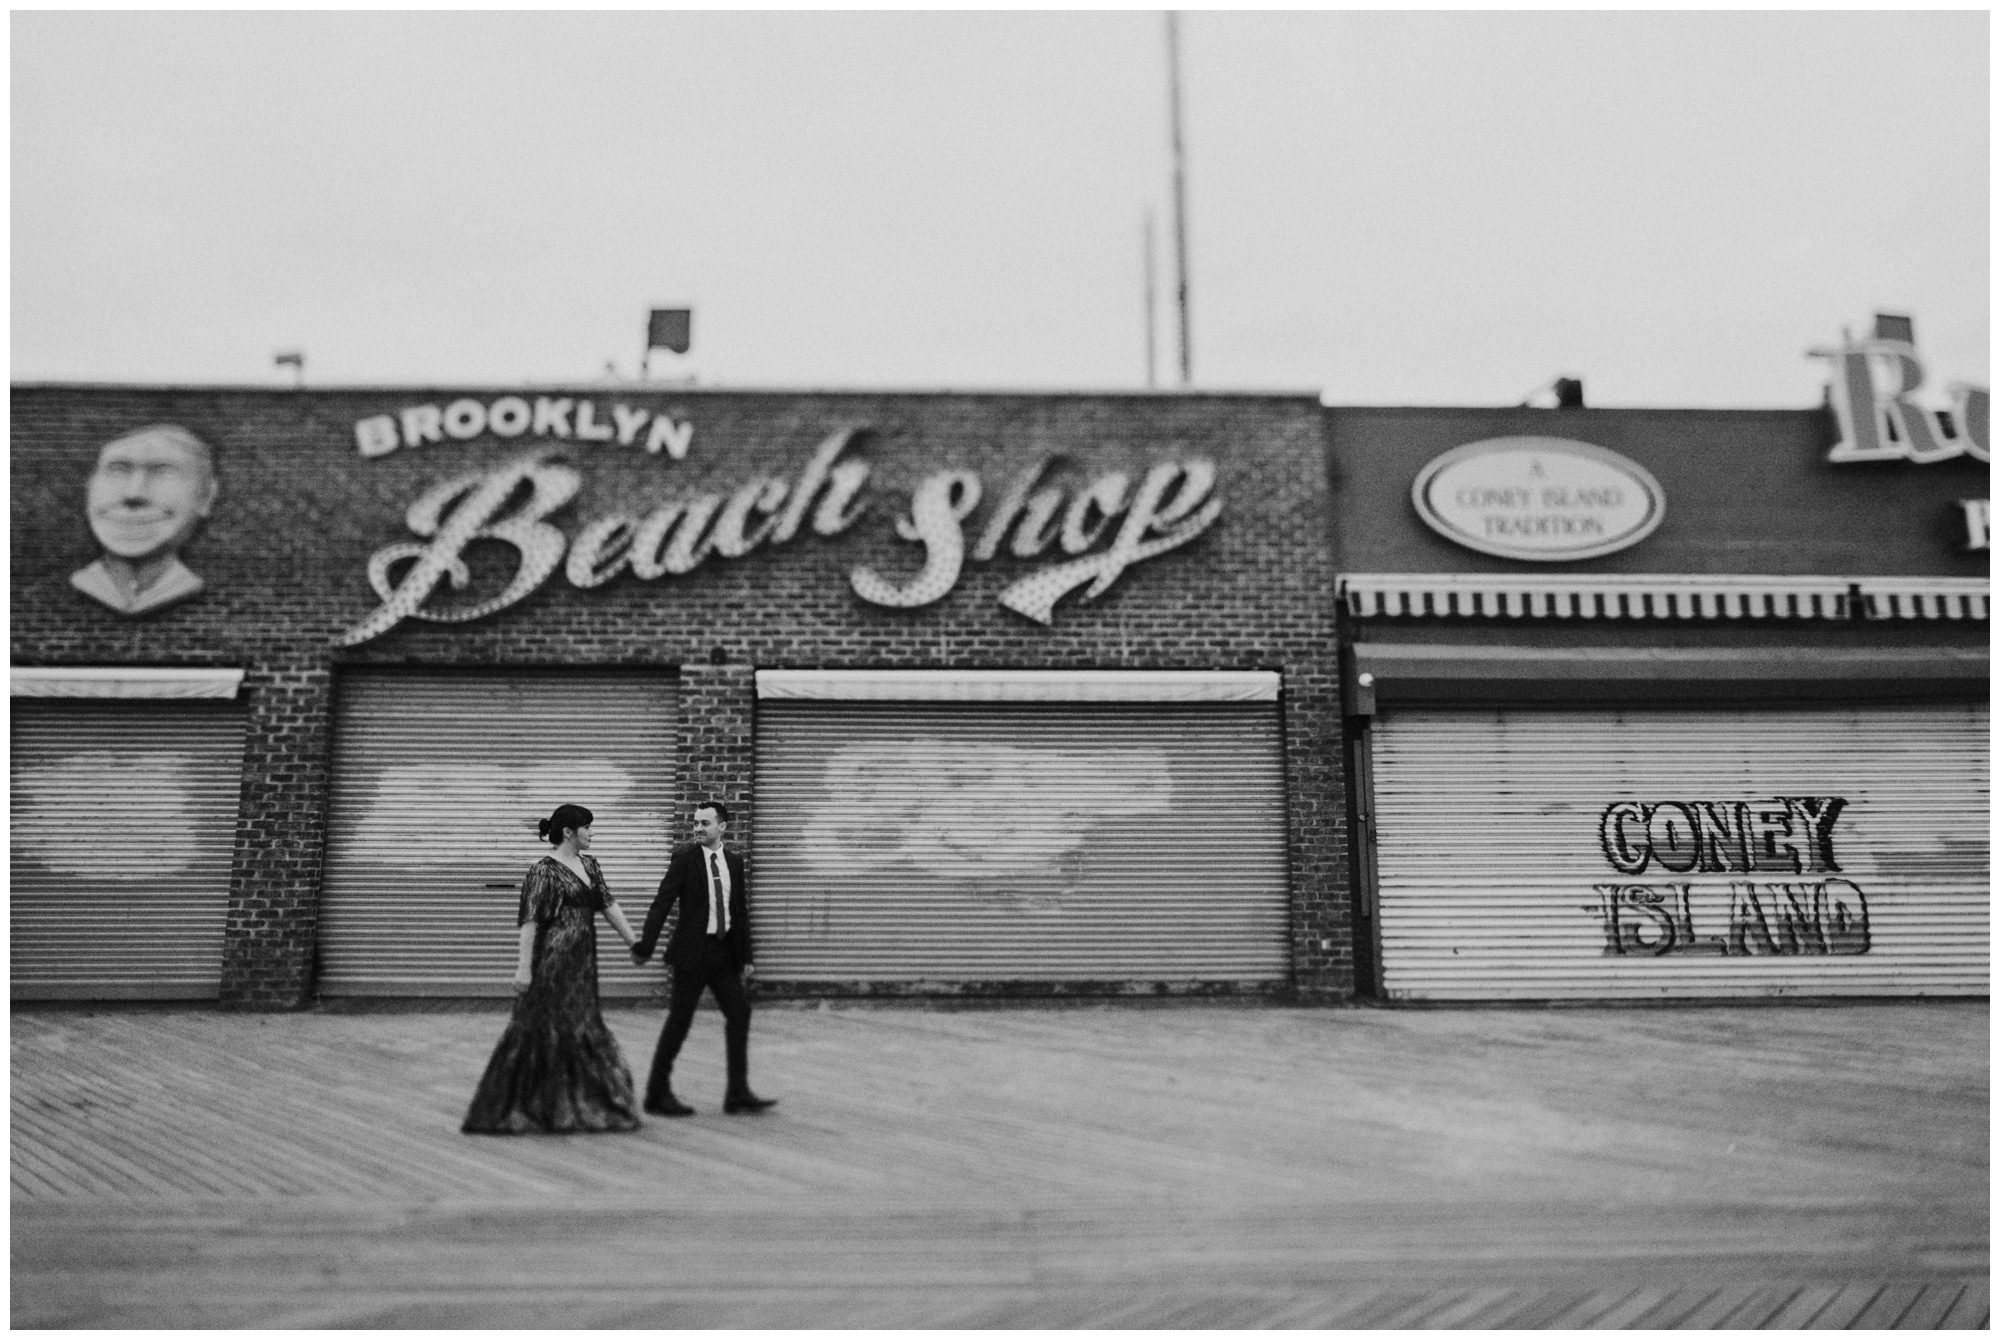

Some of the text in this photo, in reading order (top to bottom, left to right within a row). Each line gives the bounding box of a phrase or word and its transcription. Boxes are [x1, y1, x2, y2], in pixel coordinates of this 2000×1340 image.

[355, 396, 694, 459] BROOKLYN
[1455, 485, 1626, 510] CONEY ISLAND
[1528, 456, 1547, 482] A
[338, 424, 1223, 647] Beach Shop
[1483, 514, 1605, 537] TRADITION
[1600, 796, 1848, 875] CONEY
[1592, 878, 1871, 957] ISLAND
